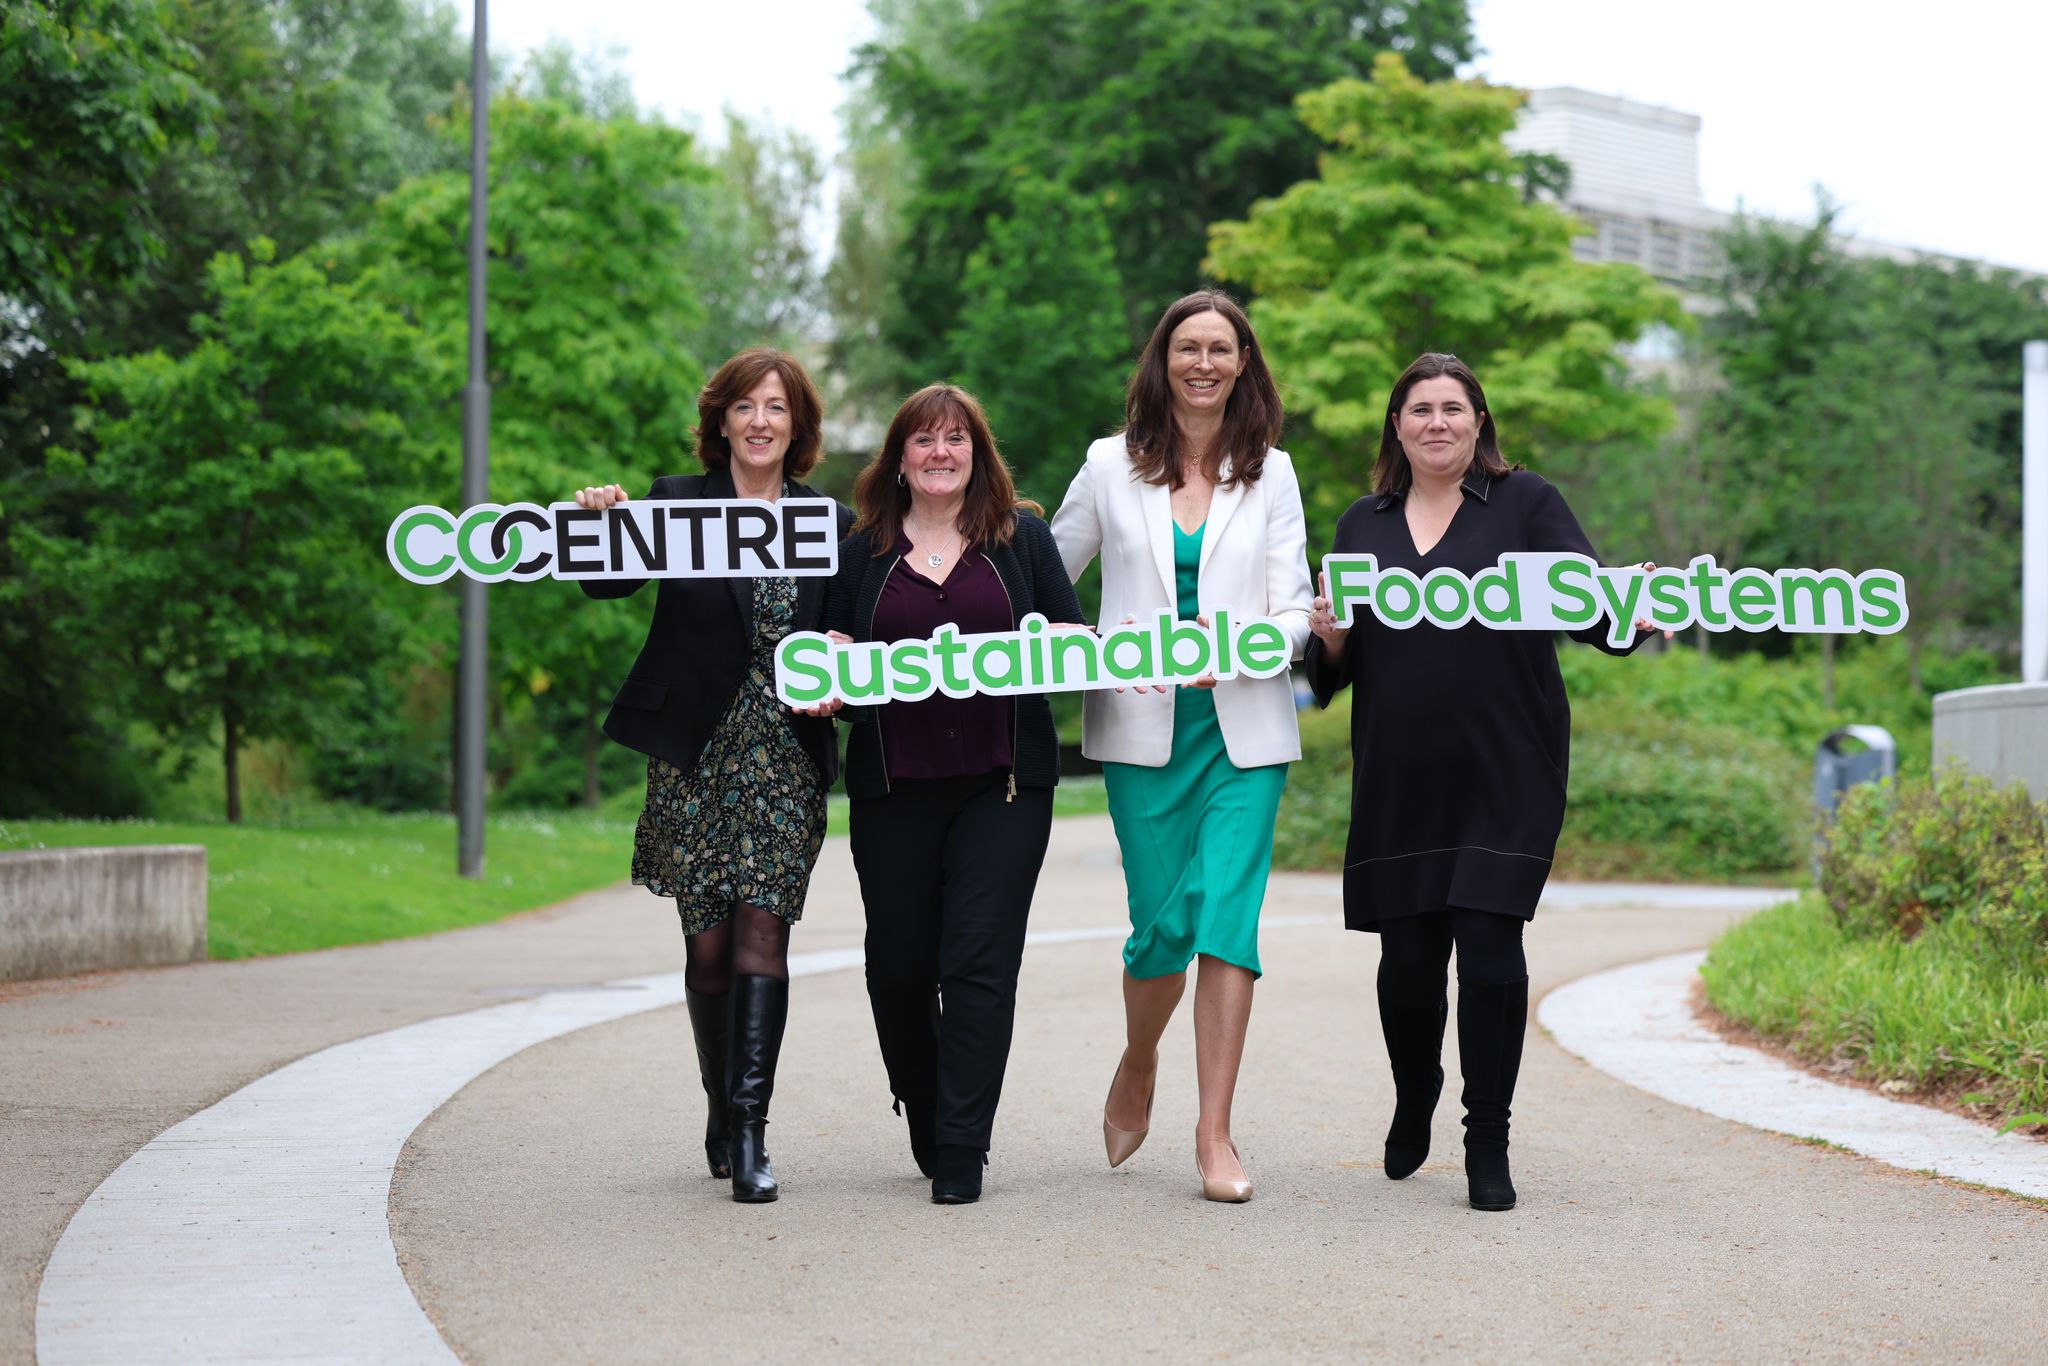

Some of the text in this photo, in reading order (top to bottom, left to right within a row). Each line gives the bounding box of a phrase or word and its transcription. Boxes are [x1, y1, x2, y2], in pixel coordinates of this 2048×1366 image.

[394, 505, 832, 577] COCENTRE
[1328, 560, 1902, 641] Food Systems
[782, 610, 1286, 702] Sustainable
